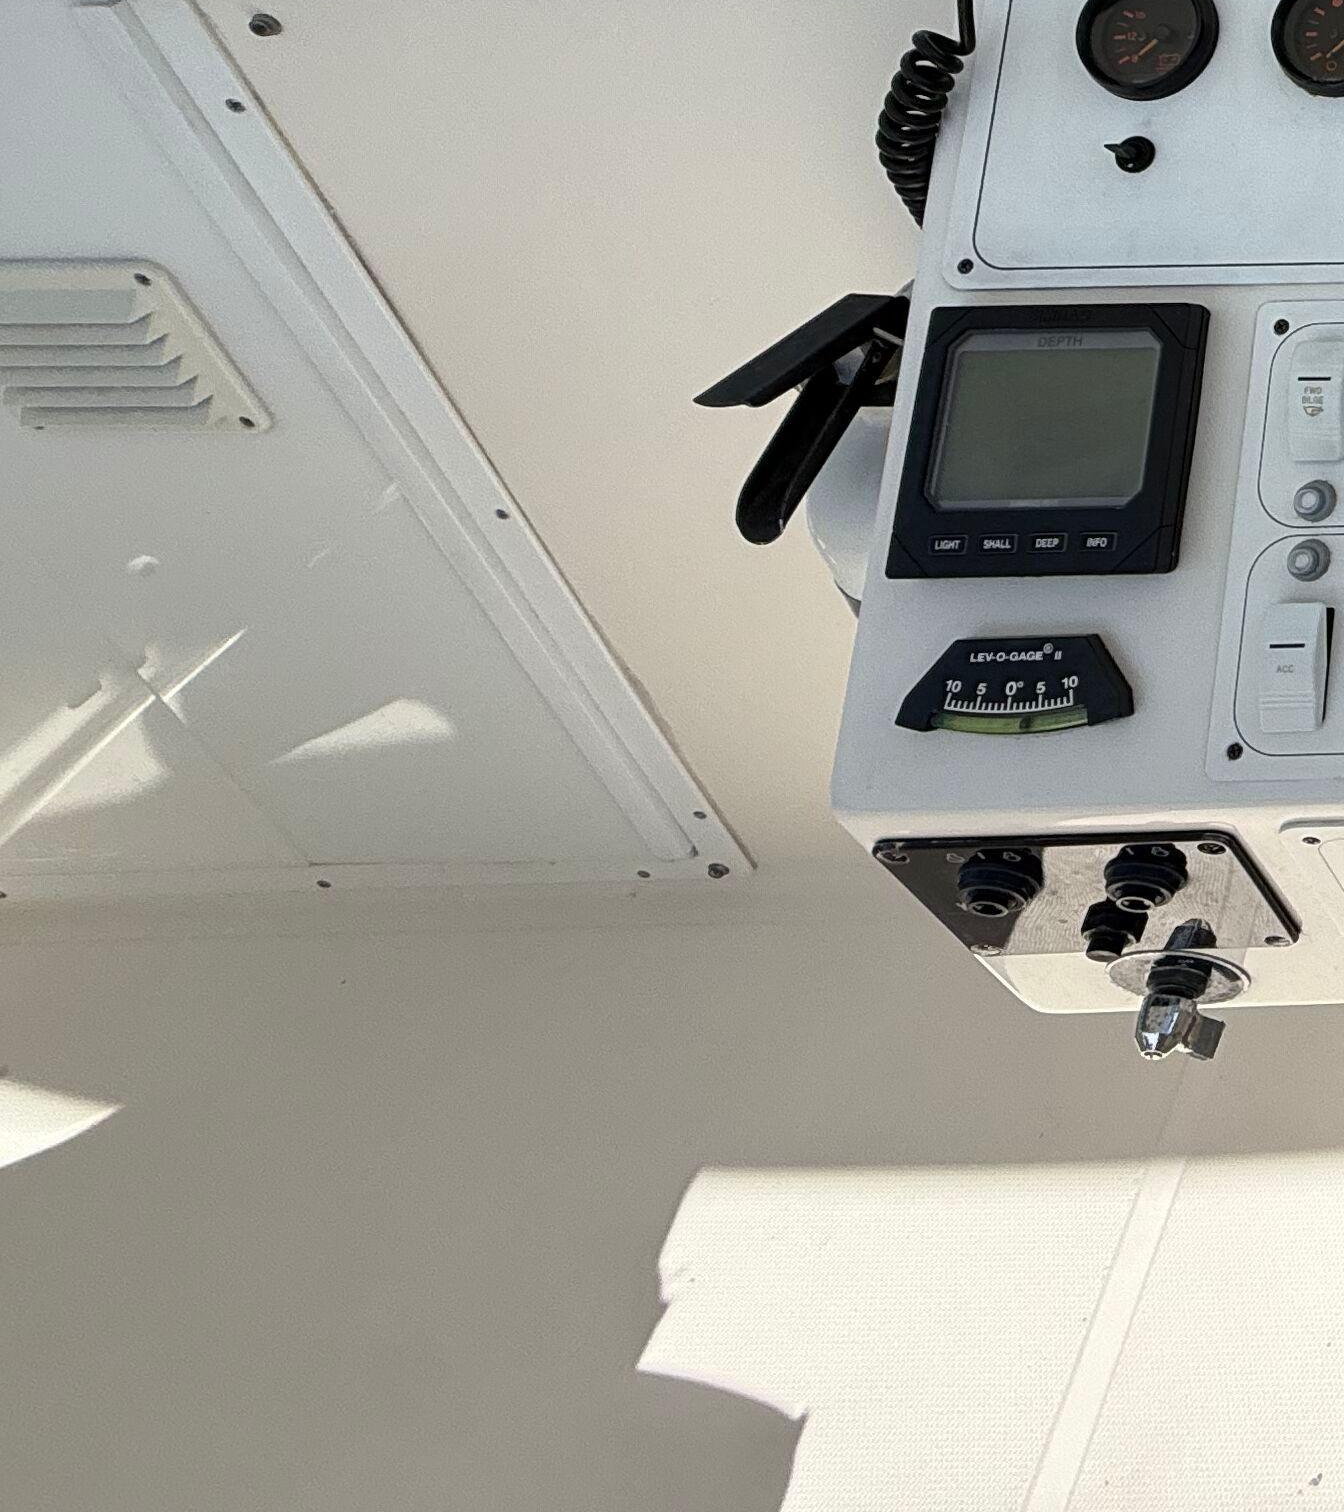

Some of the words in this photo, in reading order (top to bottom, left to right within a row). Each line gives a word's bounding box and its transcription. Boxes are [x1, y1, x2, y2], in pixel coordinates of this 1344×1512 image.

[1037, 335, 1083, 348] DEPTH
[1301, 395, 1325, 405] BILGE
[934, 540, 961, 551] LIGHT
[982, 538, 1012, 550] SHALL
[1035, 537, 1060, 548] DEEP
[1086, 537, 1108, 548] INFO
[1276, 664, 1295, 674] ACC
[945, 679, 963, 693] 10
[976, 682, 988, 695] 5
[1036, 681, 1047, 694] 5
[1061, 675, 1079, 689] 10
